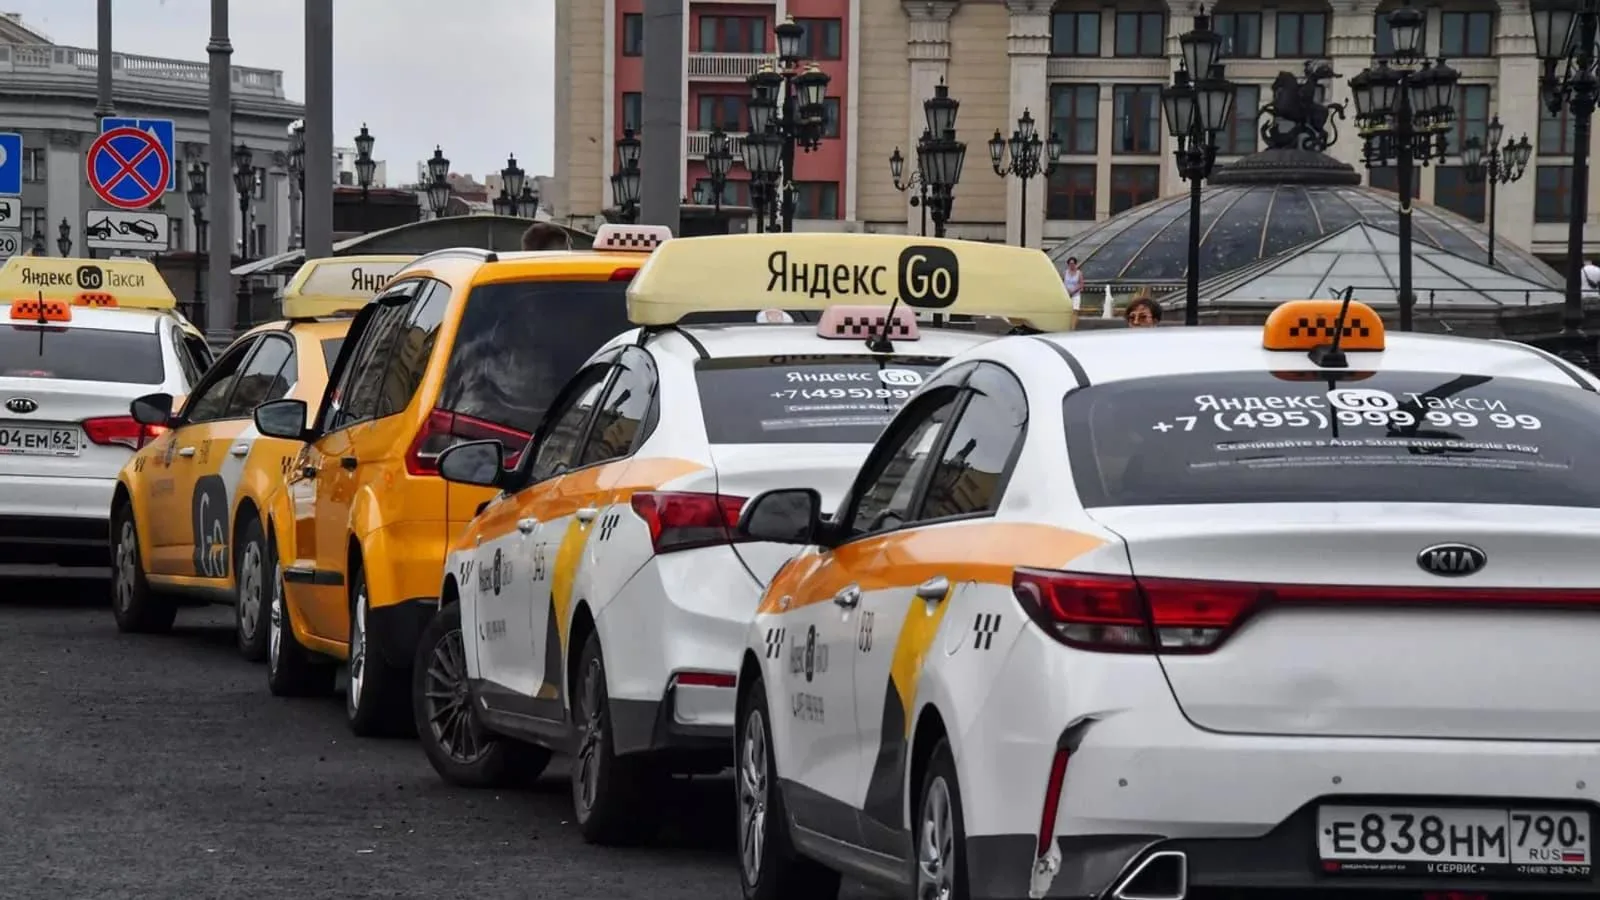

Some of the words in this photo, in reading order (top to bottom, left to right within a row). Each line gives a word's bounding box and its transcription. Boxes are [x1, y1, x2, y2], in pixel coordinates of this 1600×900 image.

[22, 267, 73, 287] Яндекс
[79, 268, 101, 287] Go
[106, 269, 145, 288] Такси
[351, 267, 395, 293] Янд
[766, 250, 887, 299] Яндекс
[904, 253, 952, 300] Go
[786, 371, 873, 383] Яндекс
[883, 370, 918, 384] Go
[11, 400, 33, 409] KIA
[1194, 394, 1326, 412] Яндекс
[1334, 391, 1391, 408] Go
[1402, 392, 1508, 412] Такси
[1152, 415, 1198, 432] +7
[1213, 410, 1329, 432] (495)
[1336, 410, 1416, 427] 999
[1425, 411, 1479, 428] 99
[1489, 412, 1542, 430] 99
[53, 431, 71, 445] 62
[1216, 439, 1314, 451] Скачивайте
[1329, 439, 1362, 448] App
[1365, 438, 1408, 447] Store
[1445, 439, 1503, 450] Google
[1506, 442, 1540, 454] Play
[200, 490, 226, 577] Go
[1430, 550, 1476, 571] KIA
[1512, 813, 1578, 848] 790
[1529, 848, 1561, 860] RUS
[1436, 863, 1478, 873] СЕРВИС
